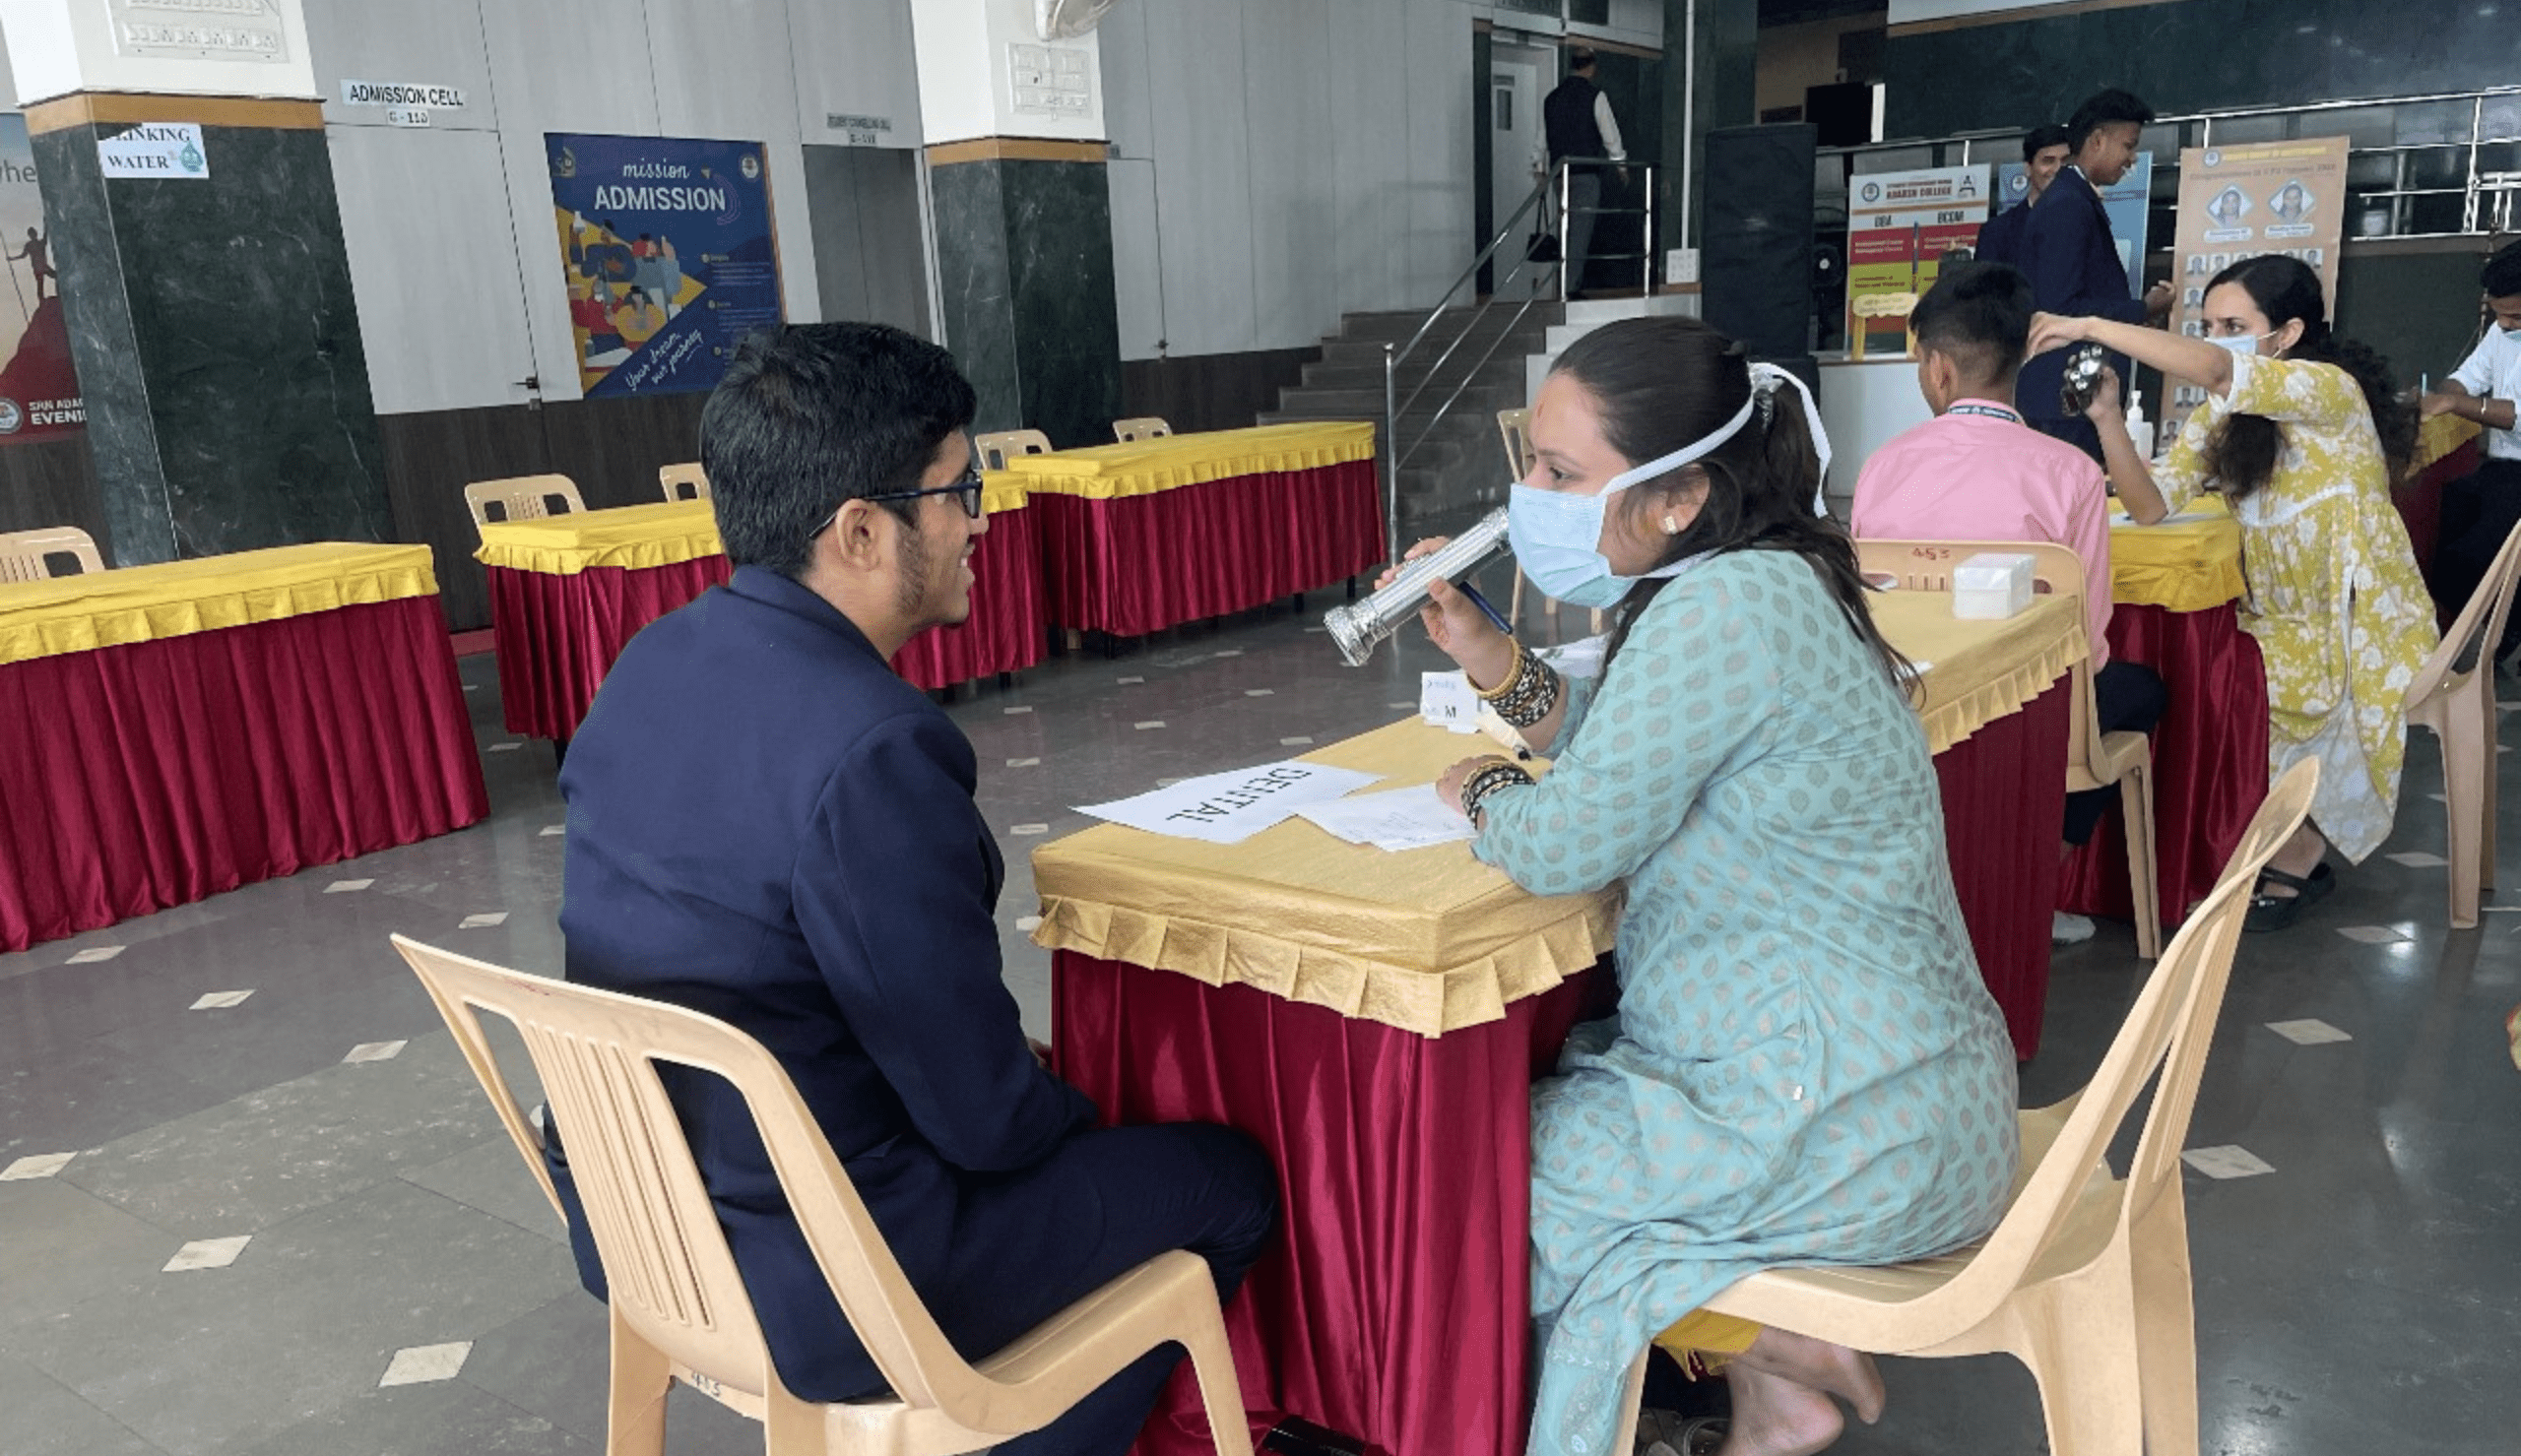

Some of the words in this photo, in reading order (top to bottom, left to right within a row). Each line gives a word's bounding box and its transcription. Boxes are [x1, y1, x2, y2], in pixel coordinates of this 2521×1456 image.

[350, 85, 426, 104] ADMISSION
[428, 89, 464, 105] CELL
[116, 128, 190, 143] INKING
[0, 159, 36, 183] he
[107, 156, 169, 168] WATER
[622, 158, 690, 179] mission
[594, 185, 727, 211] ADMISSION
[1165, 768, 1313, 823] DENTAL
